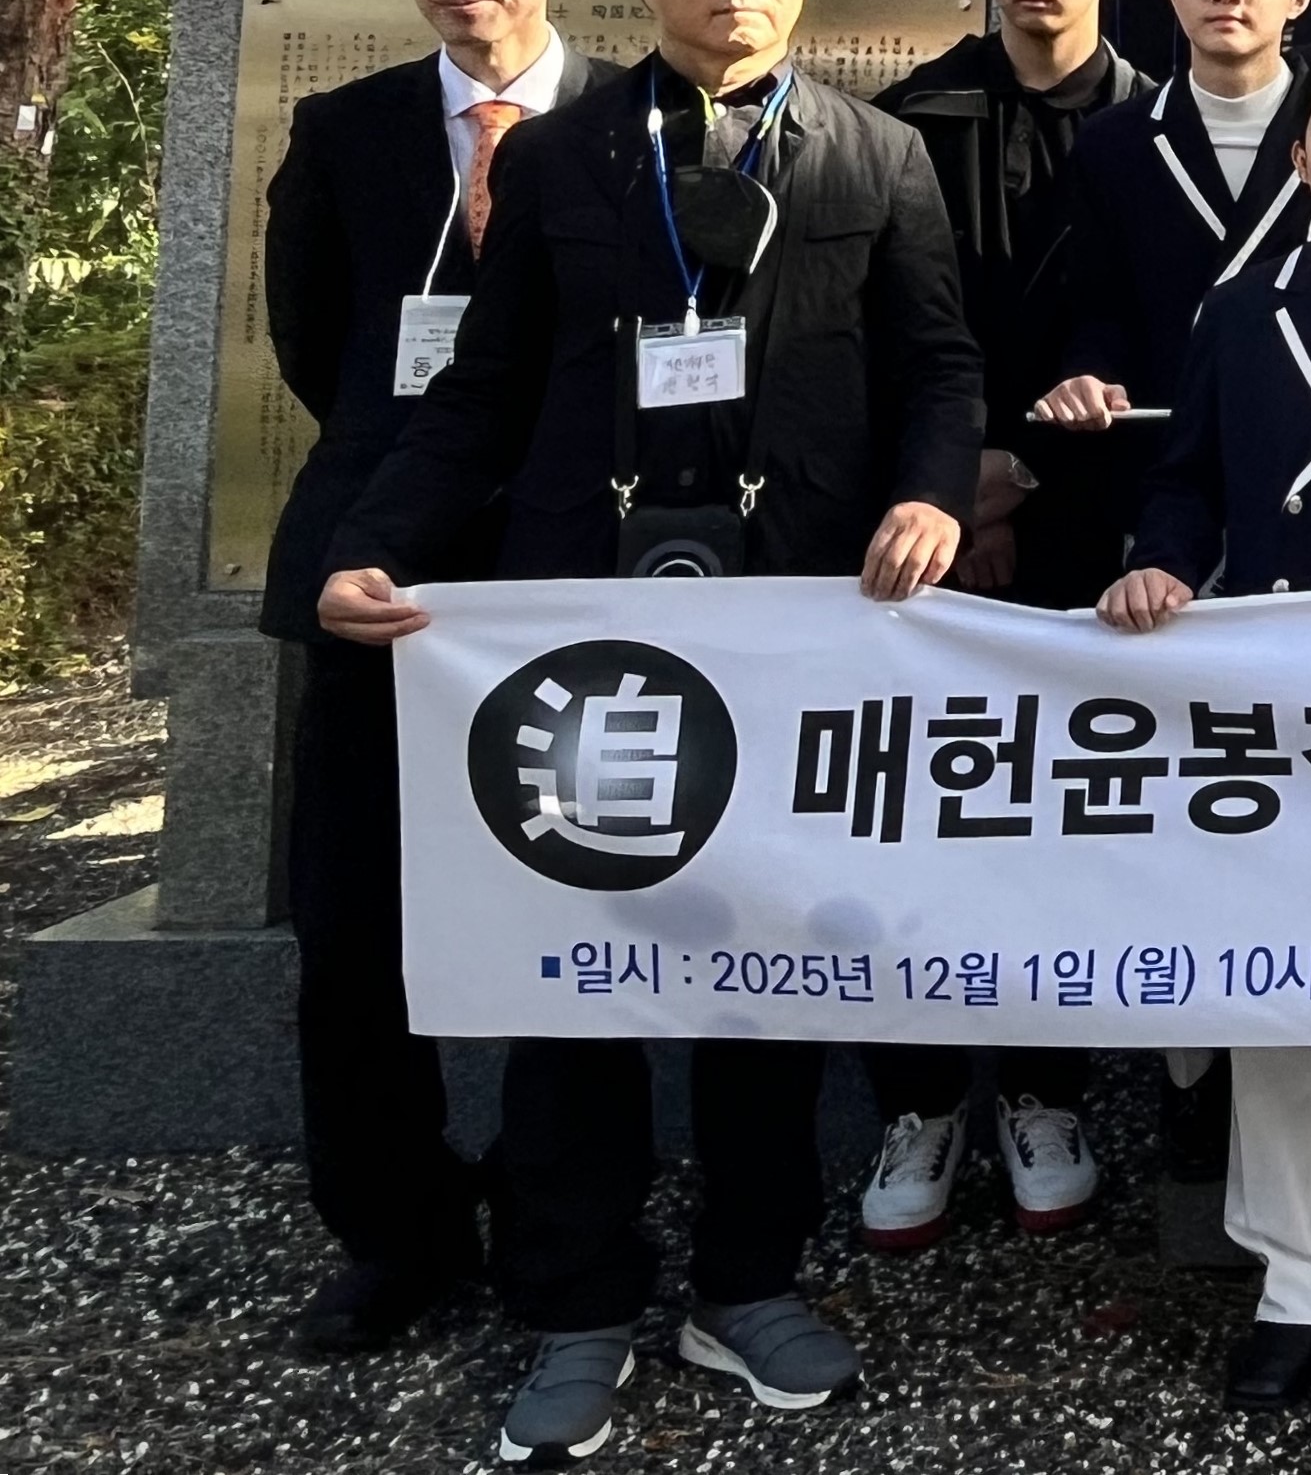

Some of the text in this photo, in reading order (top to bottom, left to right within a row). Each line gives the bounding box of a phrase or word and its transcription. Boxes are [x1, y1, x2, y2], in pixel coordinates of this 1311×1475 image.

[515, 672, 686, 857] 追
[571, 941, 661, 995] 일시
[710, 950, 875, 1003] 2025년
[896, 952, 999, 1007] 12월
[1023, 949, 1095, 1007] 1일
[1115, 944, 1196, 1008] (월)
